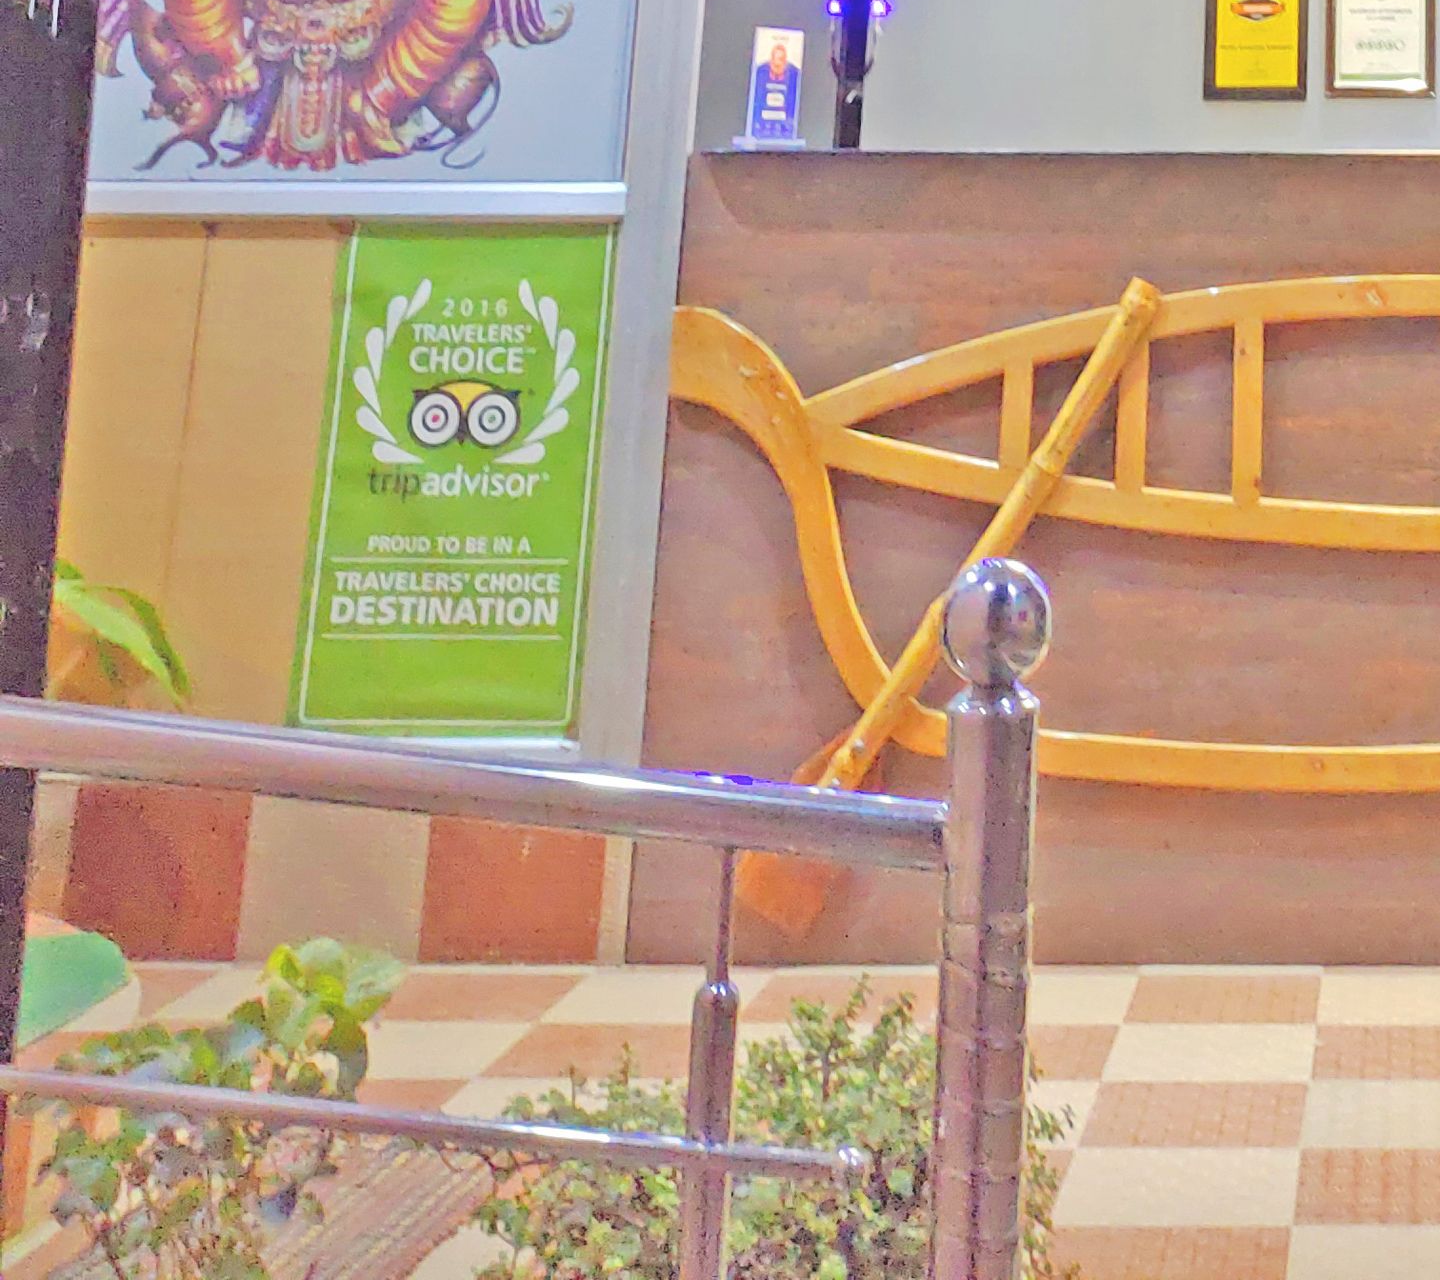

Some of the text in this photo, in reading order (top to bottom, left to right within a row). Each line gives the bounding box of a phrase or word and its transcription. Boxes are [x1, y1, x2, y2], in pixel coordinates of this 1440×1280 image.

[441, 297, 509, 319] 2016
[368, 463, 541, 504] tripadvisor
[367, 535, 532, 554] PROUD TO BE IN A
[473, 572, 561, 594] CHOICE
[329, 595, 560, 626] DESTINATION
